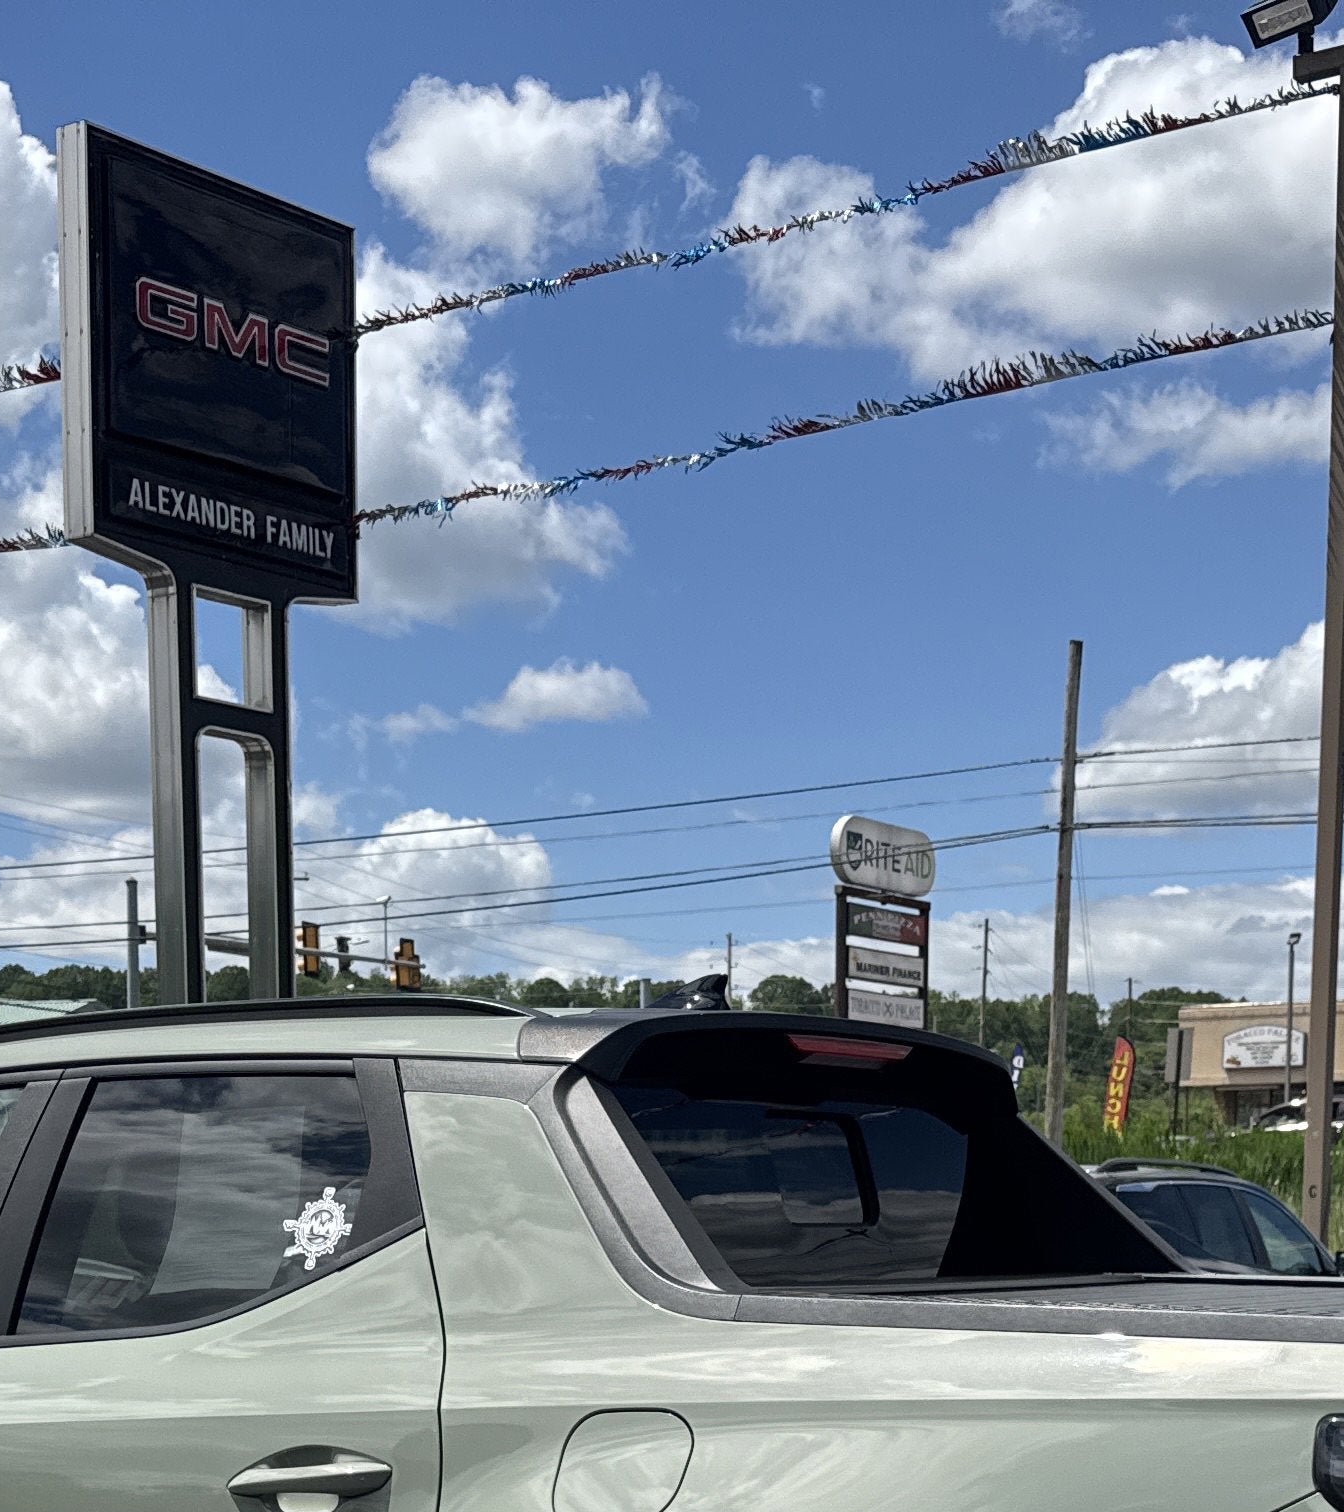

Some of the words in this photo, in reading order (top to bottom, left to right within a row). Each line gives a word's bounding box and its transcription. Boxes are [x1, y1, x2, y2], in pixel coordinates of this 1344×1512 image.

[135, 276, 331, 388] GMC
[128, 477, 256, 540] ALEXANDER
[265, 514, 335, 560] FAMILY
[863, 838, 902, 873] RITE
[903, 851, 932, 879] AID
